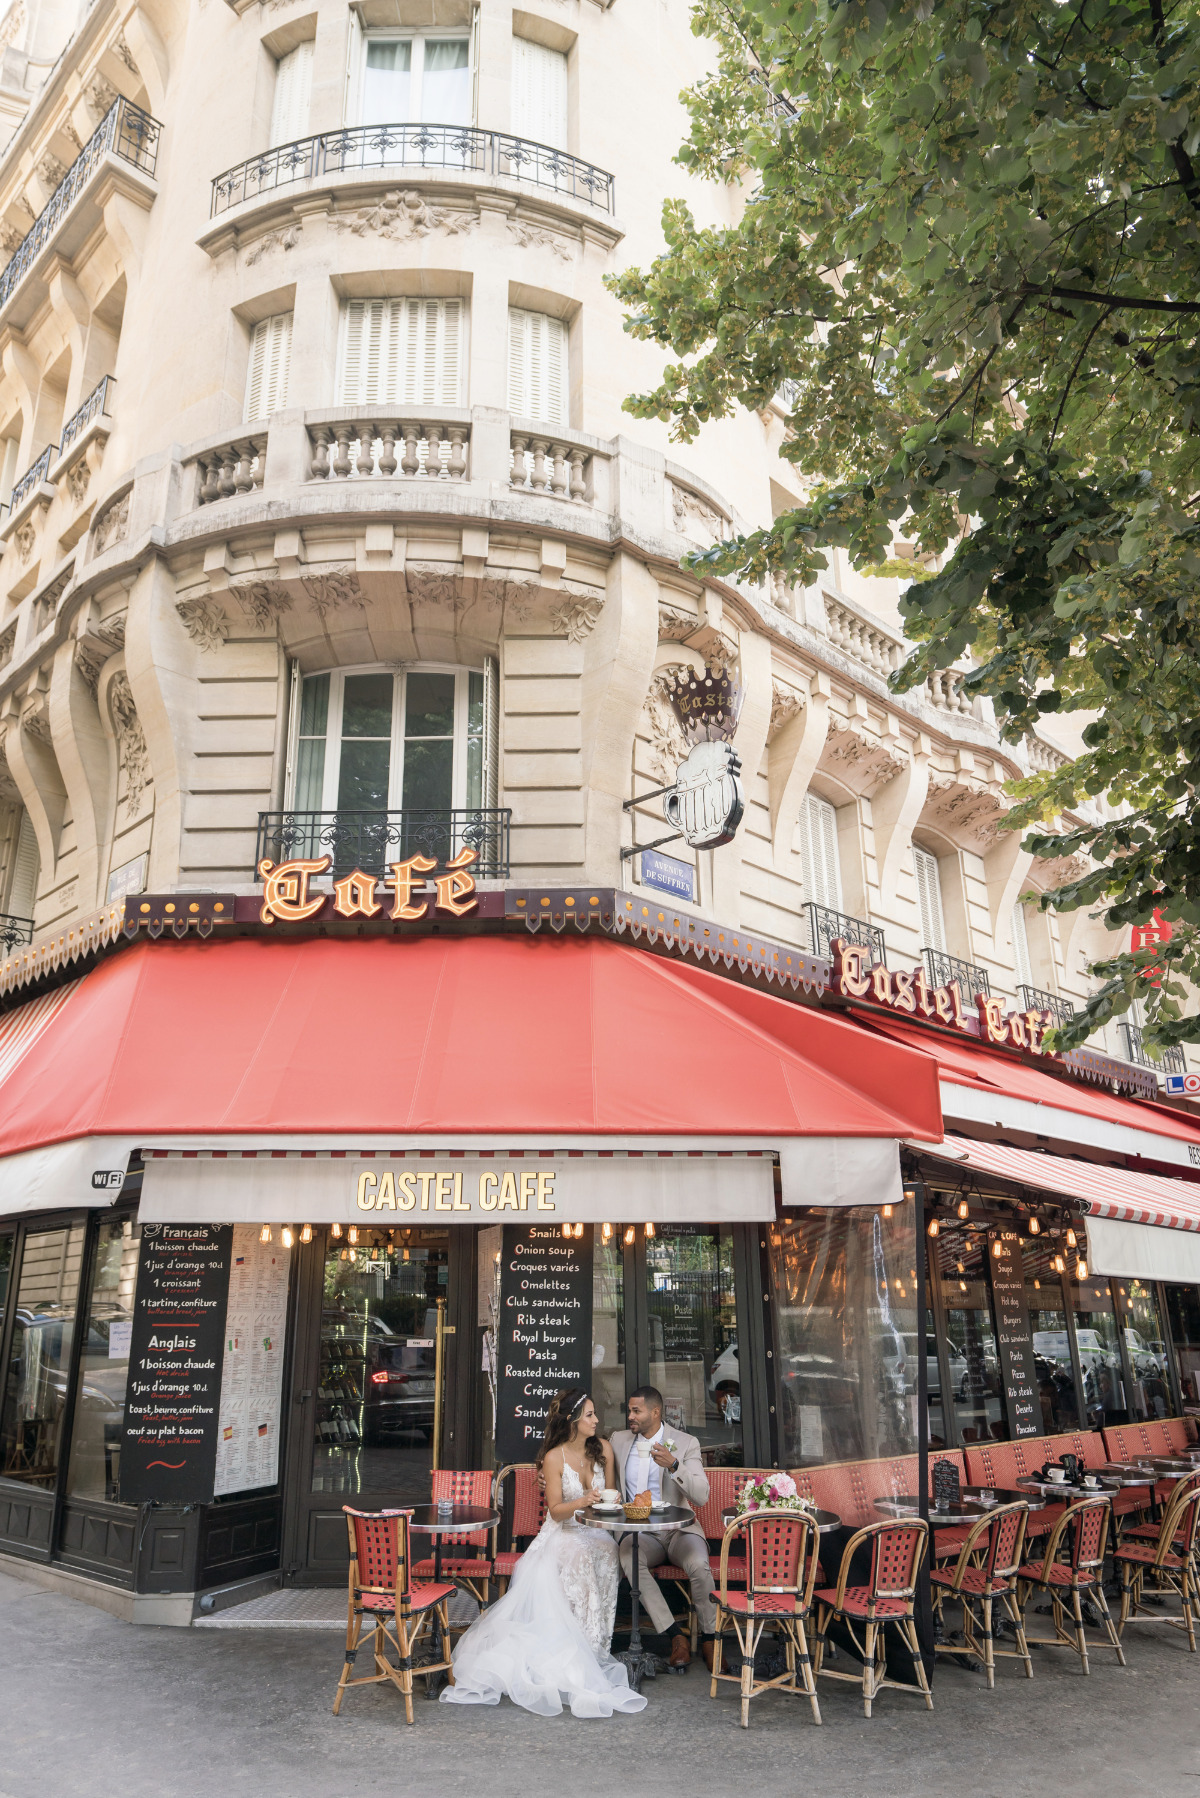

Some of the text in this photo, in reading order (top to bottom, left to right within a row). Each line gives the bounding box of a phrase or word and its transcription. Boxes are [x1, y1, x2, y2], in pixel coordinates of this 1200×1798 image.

[677, 693, 738, 715] Castel
[655, 861, 683, 878] AVENUE
[258, 846, 480, 927] Café
[646, 869, 689, 892] DE SUFFREN
[831, 937, 968, 1029] Castel
[357, 1170, 556, 1211] CASTEL CAFE
[163, 1226, 208, 1238] Français
[529, 1228, 560, 1238] Snails
[188, 1242, 218, 1250] chaude
[514, 1244, 574, 1258] Onion soup
[510, 1261, 579, 1274] Croques variés
[998, 1263, 1012, 1276] Soups
[154, 1278, 201, 1287] 1 croissant
[521, 1279, 570, 1290] Omelettes
[994, 1280, 1009, 1291] Croques
[506, 1296, 580, 1308] Club sandwich
[1001, 1296, 1019, 1308] Hot dog
[674, 1305, 692, 1315] Pasta
[517, 1314, 570, 1326] Rib steak
[1004, 1315, 1021, 1327] Burgers
[148, 1335, 196, 1352] Anglais
[513, 1330, 576, 1346] Royal burger
[1000, 1333, 1029, 1343] Club sandwich
[529, 1348, 557, 1360] Pasta
[1010, 1351, 1023, 1361] Pasta
[184, 1358, 215, 1369] chaude
[505, 1364, 580, 1378] Roasted chicken
[1012, 1369, 1025, 1379] Pizza
[152, 1380, 189, 1395] d'orange
[524, 1384, 558, 1399] Crêpes
[1008, 1386, 1033, 1398] Rib steak
[175, 1392, 191, 1400] juice
[1016, 1404, 1033, 1415] Desserts
[159, 1426, 177, 1439] plat
[179, 1426, 204, 1434] bacon
[524, 1426, 546, 1438] Piz
[1016, 1424, 1036, 1435] Pancakes
[156, 1438, 166, 1447] egg
